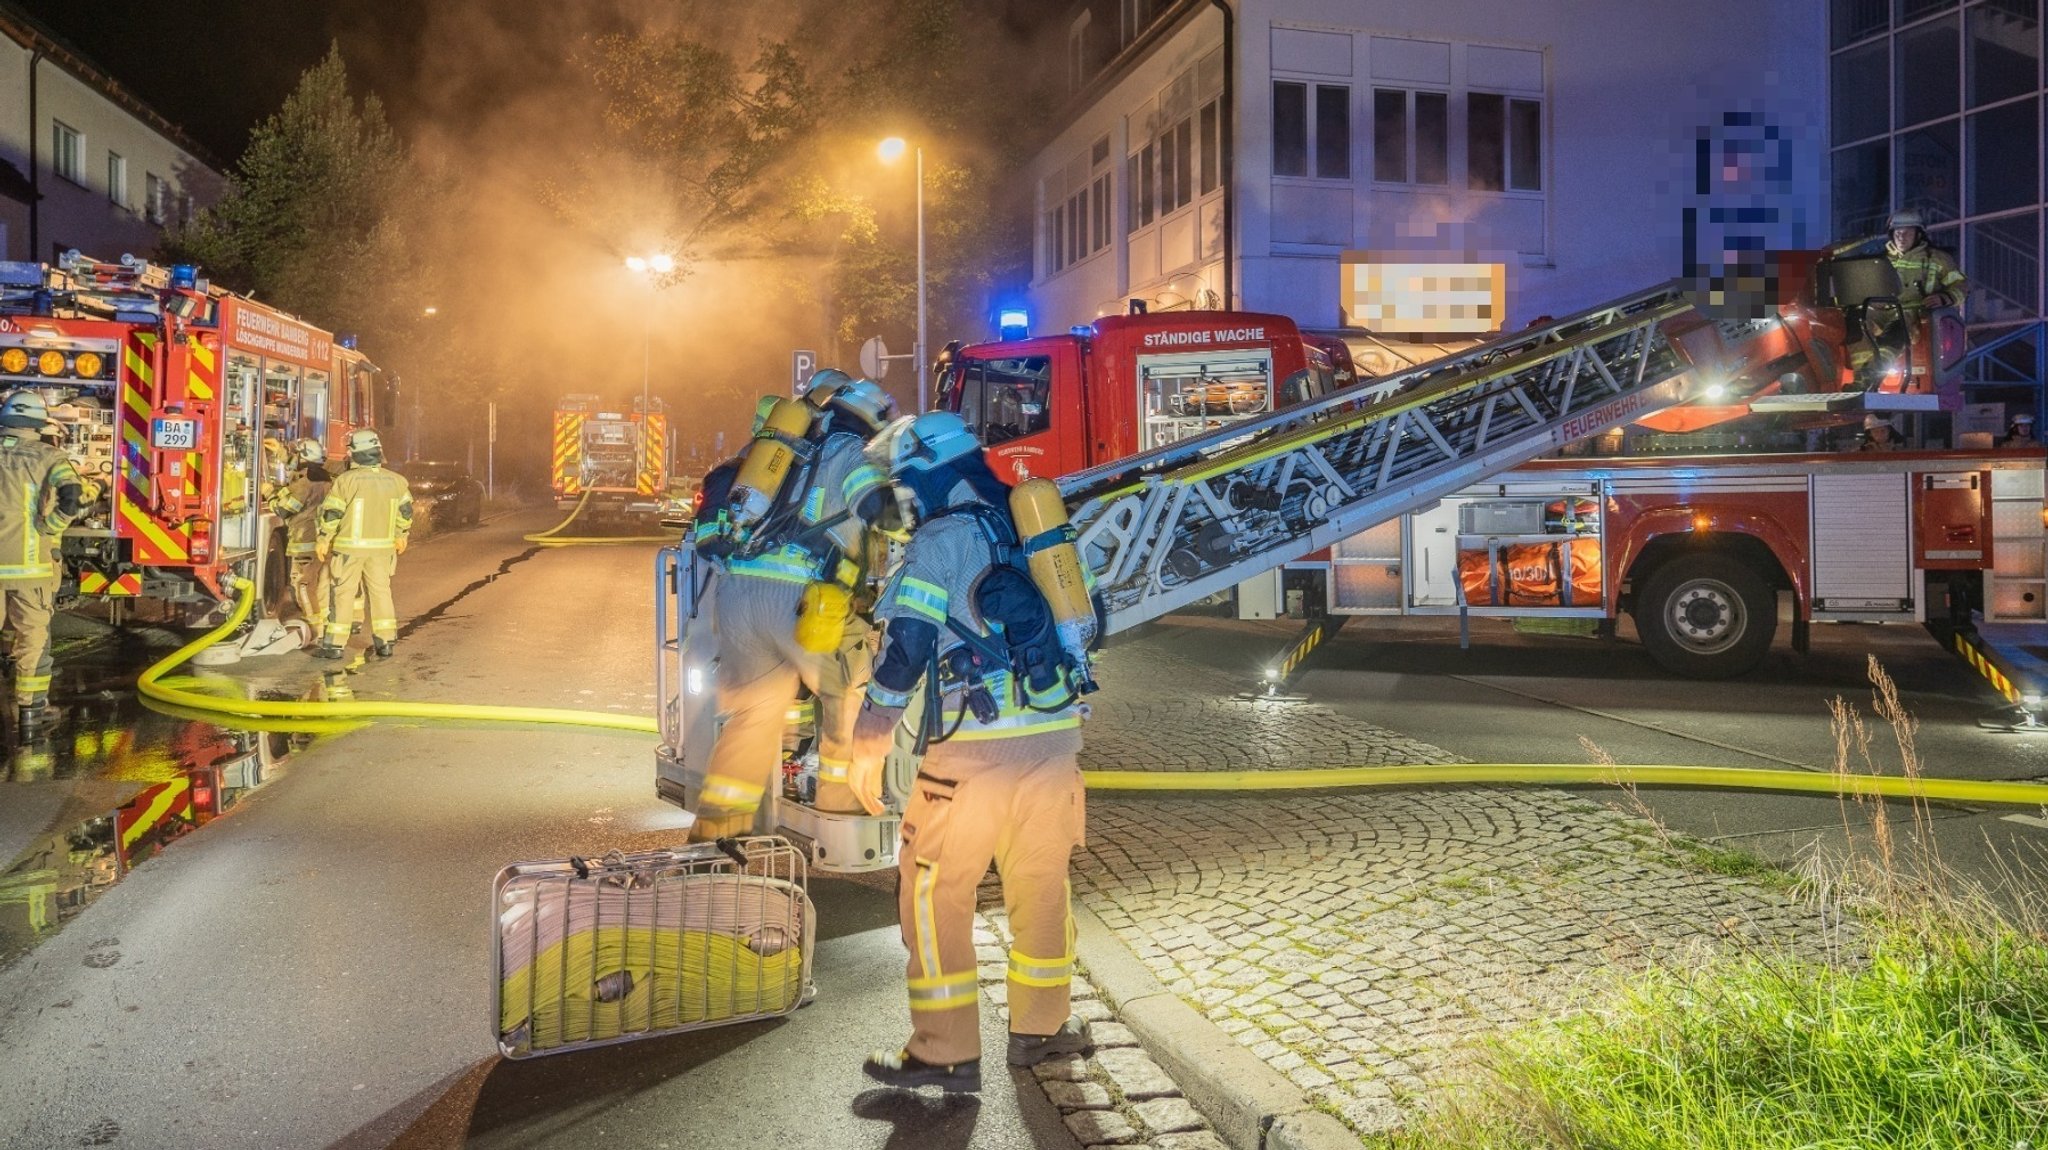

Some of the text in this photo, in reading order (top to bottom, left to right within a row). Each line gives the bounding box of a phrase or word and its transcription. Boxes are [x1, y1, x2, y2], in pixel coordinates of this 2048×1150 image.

[0, 319, 20, 332] 0/
[237, 307, 309, 347] FEUERWEHR BAMBERG
[1144, 327, 1265, 346] STÄNDIGE WACHE
[236, 327, 276, 353] LÖSCHGRUPPE
[316, 338, 329, 361] 112
[797, 355, 811, 381] P
[165, 422, 181, 433] BA
[1562, 395, 1638, 442] FEUERWEHR
[164, 434, 187, 446] 299
